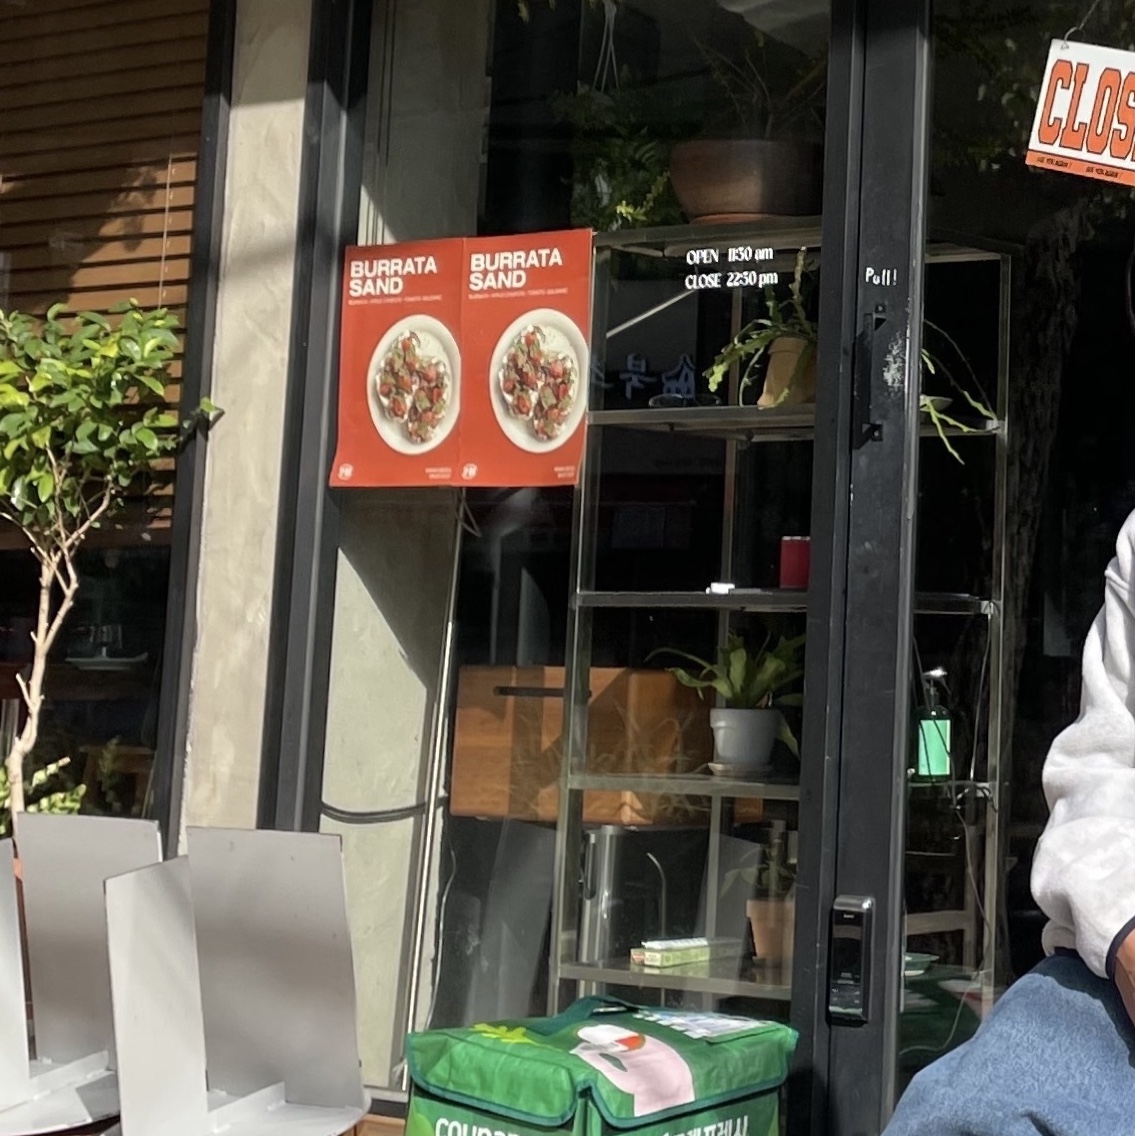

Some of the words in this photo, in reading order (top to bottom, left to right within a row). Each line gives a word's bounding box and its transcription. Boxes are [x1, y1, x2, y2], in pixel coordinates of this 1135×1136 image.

[470, 248, 563, 272] BURRATA
[686, 248, 719, 265] OPEN
[755, 247, 774, 260] am
[350, 256, 438, 278] BURRATA
[349, 277, 404, 297] SAND
[469, 270, 527, 291] SAND
[685, 272, 722, 290] CLOSE
[758, 272, 778, 289] pm
